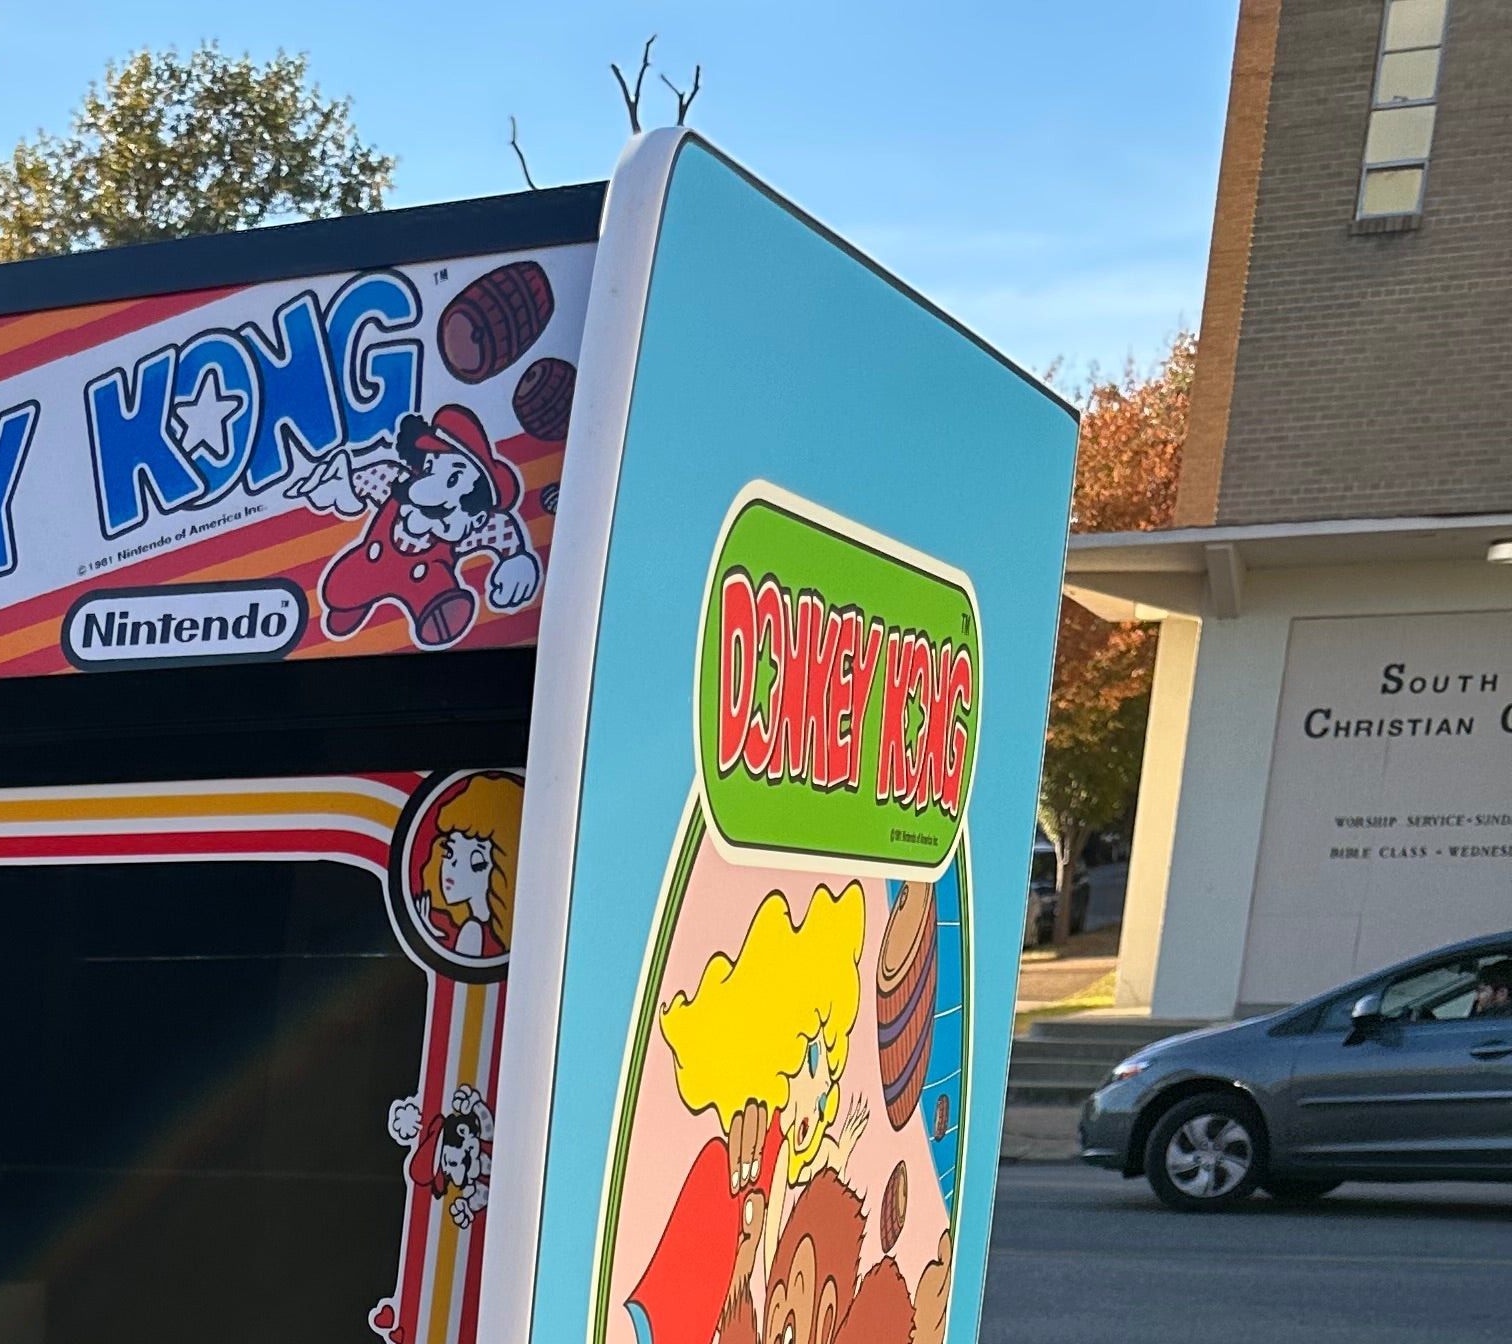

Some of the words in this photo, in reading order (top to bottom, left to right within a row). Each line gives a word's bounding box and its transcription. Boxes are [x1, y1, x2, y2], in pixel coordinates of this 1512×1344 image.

[84, 268, 423, 540] KONG
[117, 536, 172, 562] Nintendo
[175, 528, 186, 542] of
[189, 512, 242, 536] America
[81, 602, 288, 649] Nintendo
[718, 564, 885, 792] DONKEY
[876, 625, 973, 820] KONG
[1334, 815, 1398, 828] WORSHIP
[1407, 814, 1466, 827] SERVICE
[1329, 846, 1372, 859] BIBLE
[1379, 846, 1428, 859] CLASS
